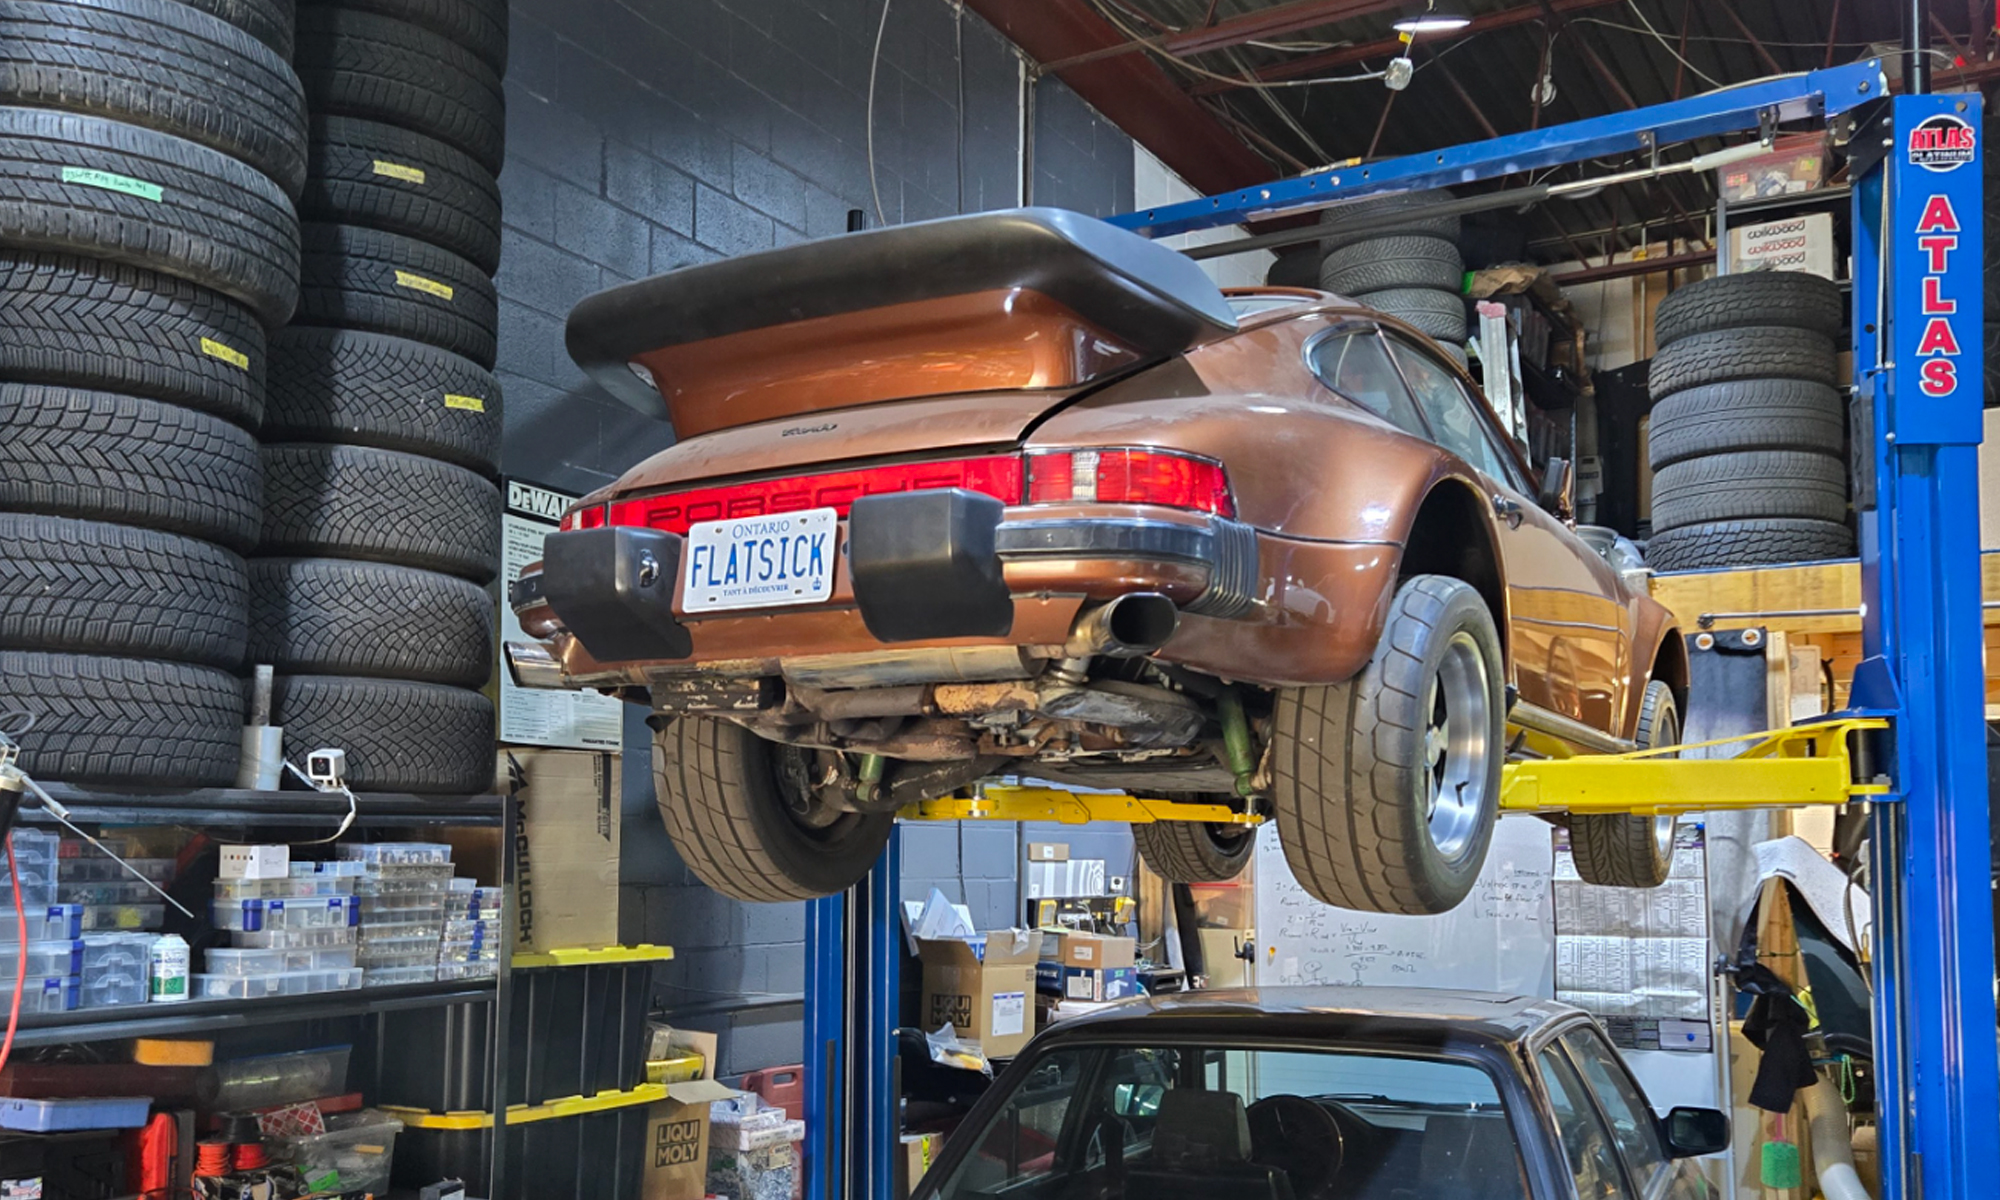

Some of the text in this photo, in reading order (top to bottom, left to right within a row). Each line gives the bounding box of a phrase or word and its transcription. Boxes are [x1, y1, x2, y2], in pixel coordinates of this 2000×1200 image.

[1910, 127, 1974, 150] ATLAS
[1911, 148, 1973, 162] PLATINUM
[1747, 219, 1805, 239] wilwood
[1747, 235, 1806, 255] wilwood
[1915, 194, 1961, 397] ATLAS
[648, 474, 961, 521] PORSC
[732, 519, 790, 539] ONTARIO
[691, 532, 826, 589] FLATSICK
[722, 587, 742, 597] TANT
[932, 995, 970, 1010] LIQUI
[932, 1011, 970, 1027] MOLY
[658, 1120, 699, 1144] LIQUI
[656, 1142, 699, 1166] MOLY
